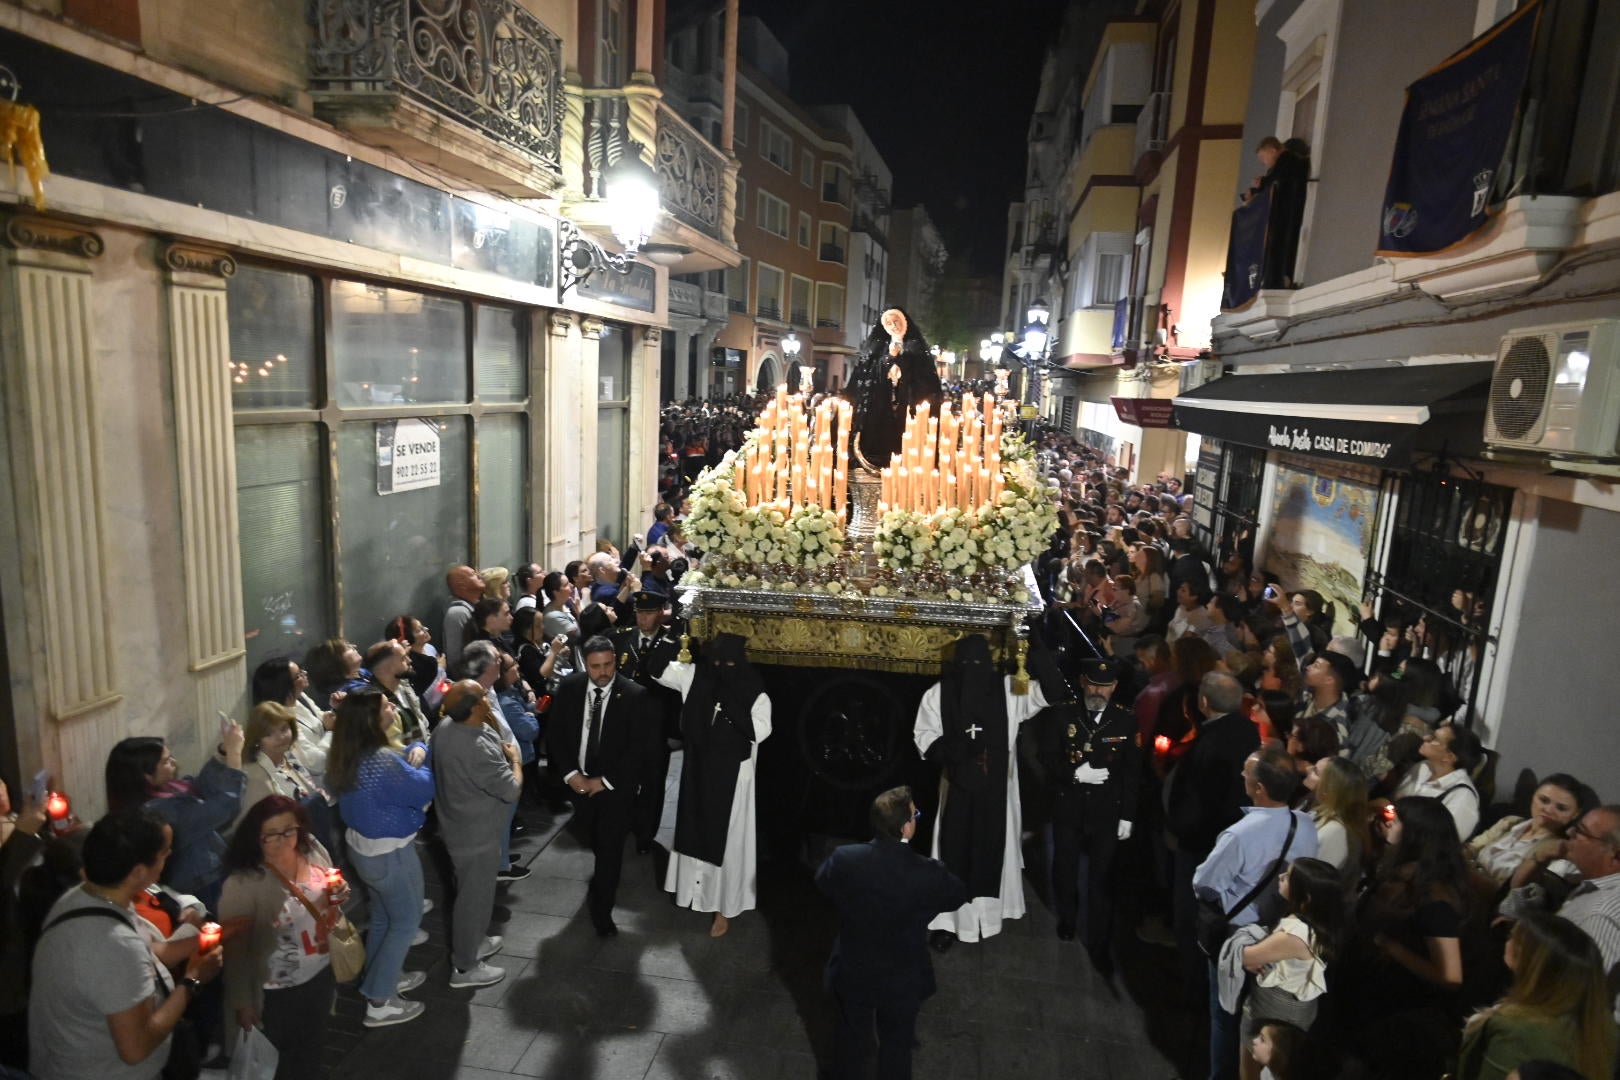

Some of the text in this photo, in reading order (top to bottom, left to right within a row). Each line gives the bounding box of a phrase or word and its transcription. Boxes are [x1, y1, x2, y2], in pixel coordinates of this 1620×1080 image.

[396, 441, 436, 457] SE VENDE
[1314, 435, 1335, 452] CASA
[1336, 438, 1349, 454] DE
[1350, 439, 1391, 458] COMIDAS
[396, 465, 409, 478] 902
[410, 464, 418, 476] 22
[420, 463, 428, 475] 55
